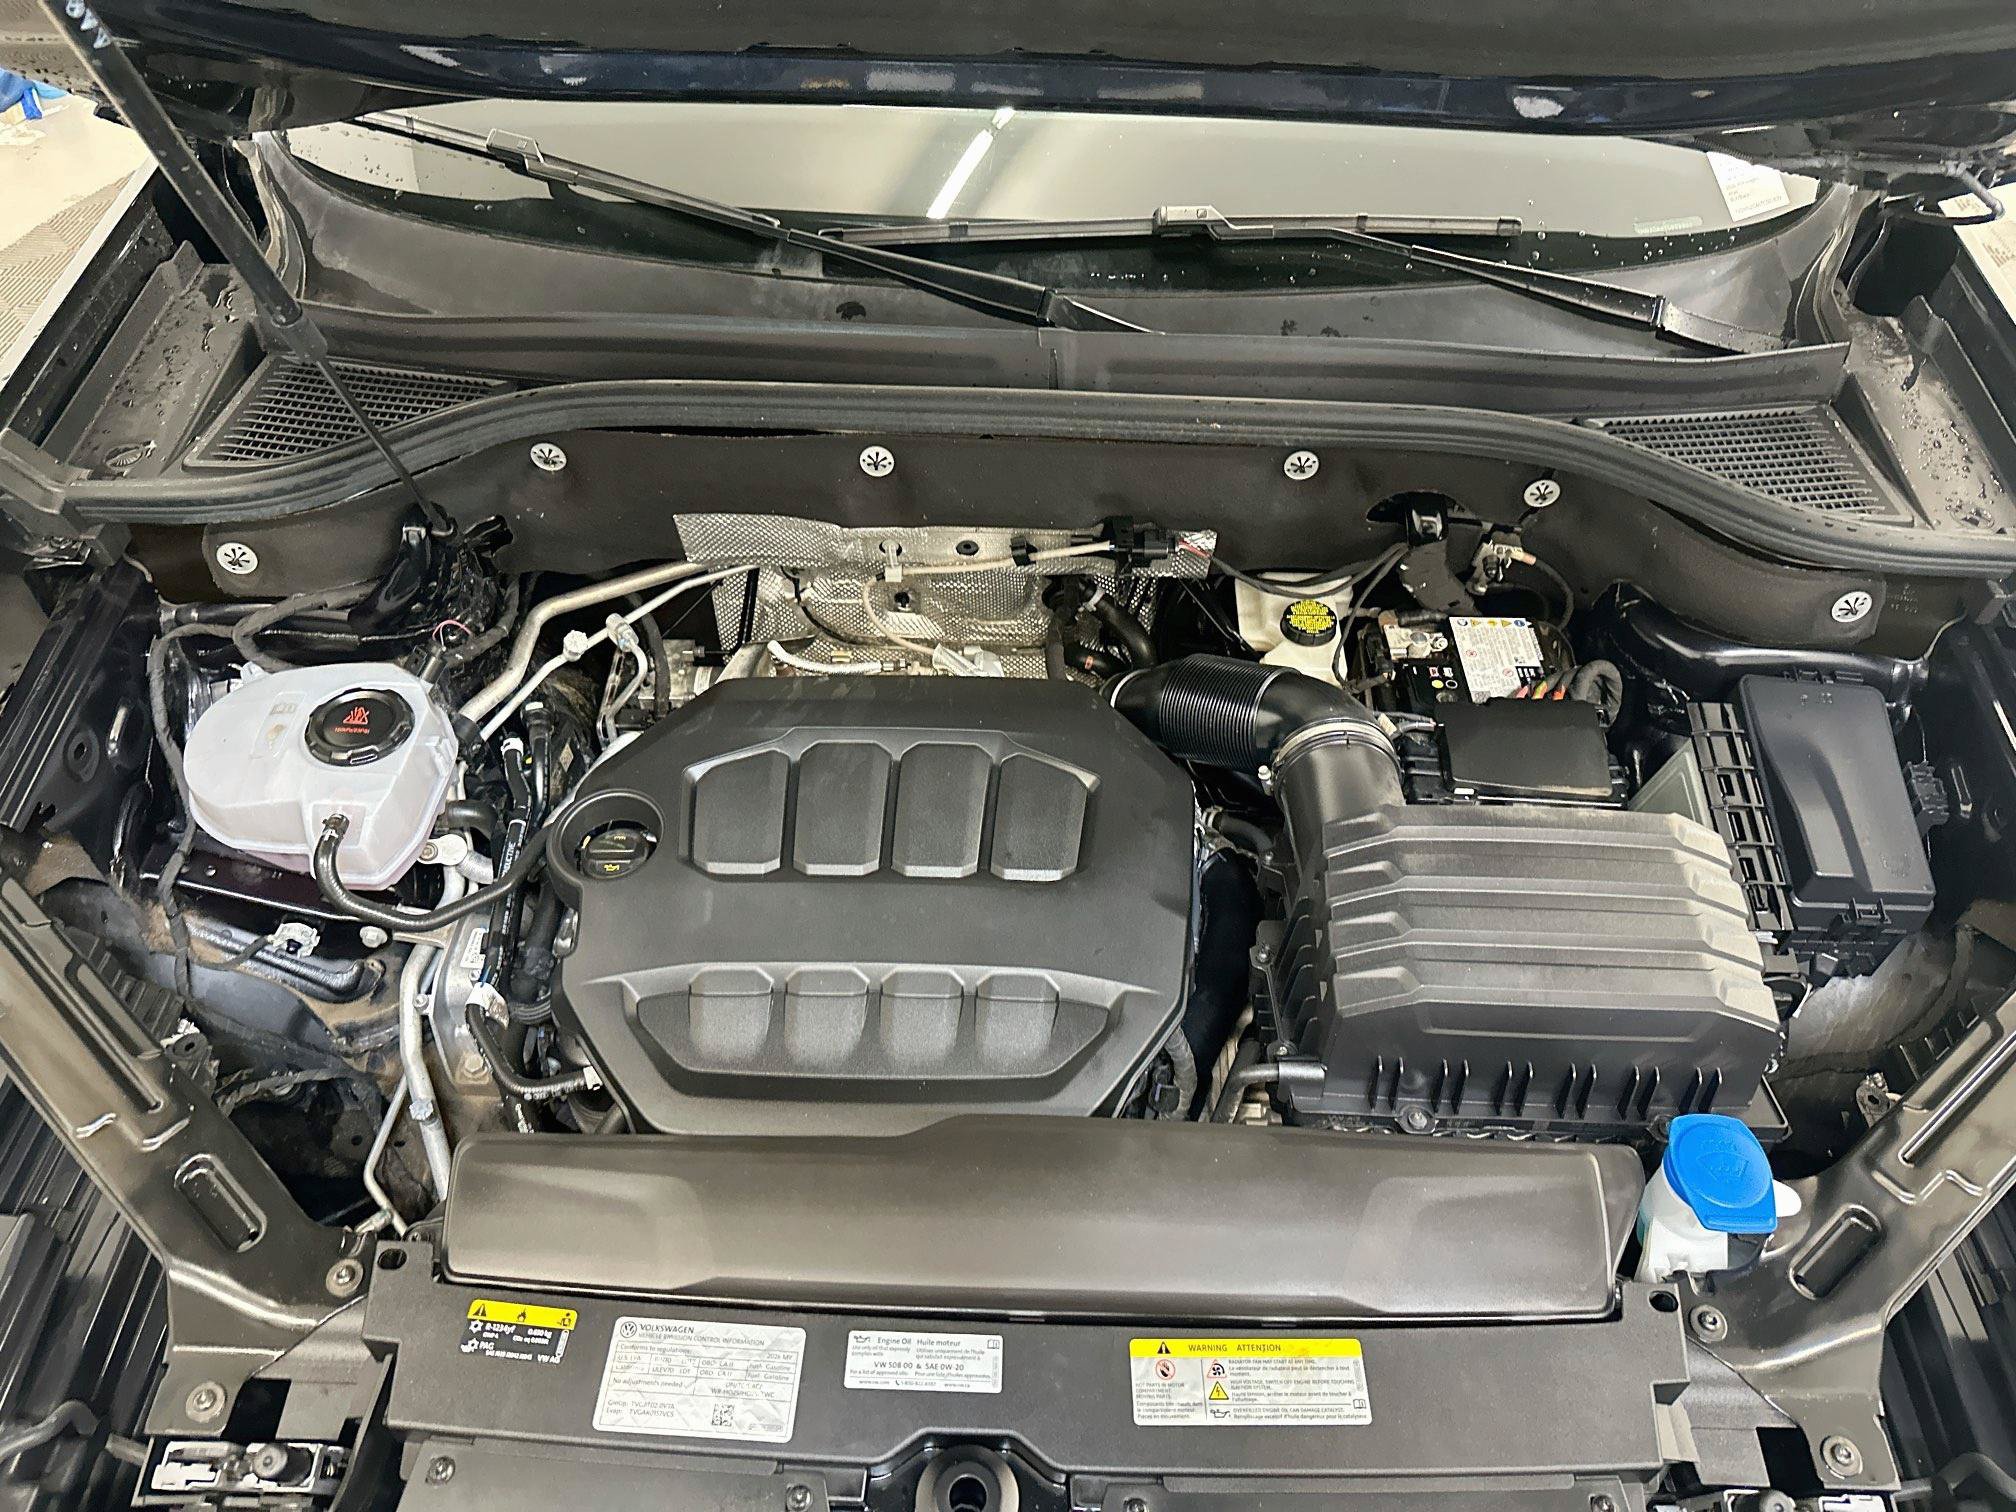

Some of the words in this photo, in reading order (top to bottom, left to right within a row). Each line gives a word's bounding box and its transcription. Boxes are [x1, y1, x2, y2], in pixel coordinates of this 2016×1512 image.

[639, 1323, 695, 1334] VOLKSWAGEN
[878, 1337, 900, 1345] Engine
[917, 1338, 935, 1346] Huile
[479, 1341, 495, 1350] PAG
[1188, 1344, 1228, 1352] WARNING
[1236, 1344, 1281, 1352] ATTENTION
